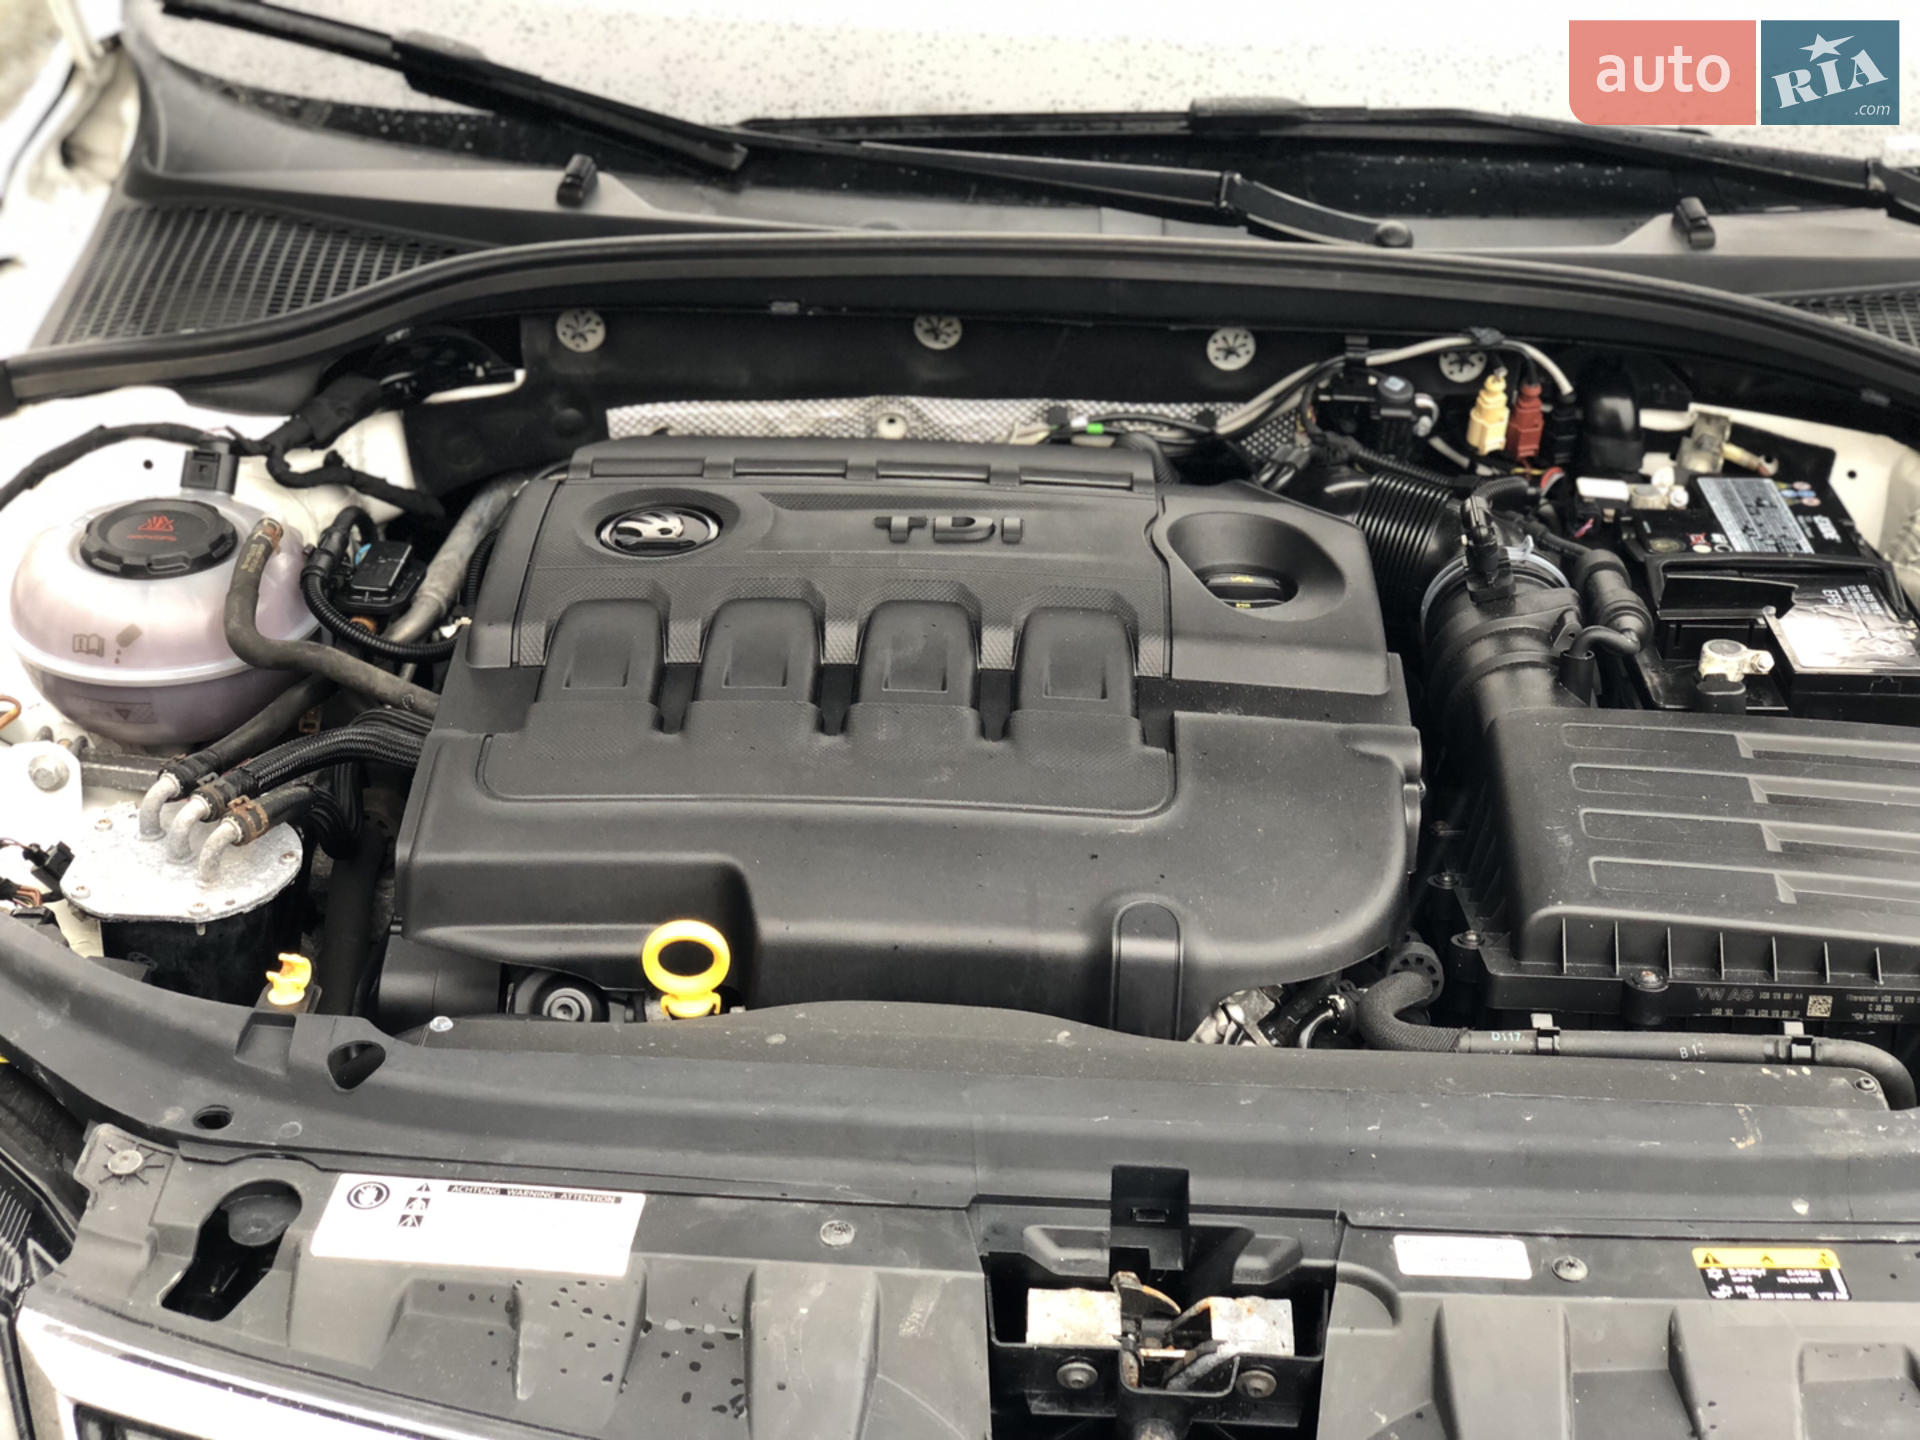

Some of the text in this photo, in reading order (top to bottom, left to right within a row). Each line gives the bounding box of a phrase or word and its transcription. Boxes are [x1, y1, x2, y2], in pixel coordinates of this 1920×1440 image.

[873, 515, 1025, 543] TDI
[1695, 987, 1726, 1001] VW
[1727, 988, 1755, 1002] AG
[451, 1185, 615, 1203] ACHTUNG WARNING ATTENTION
